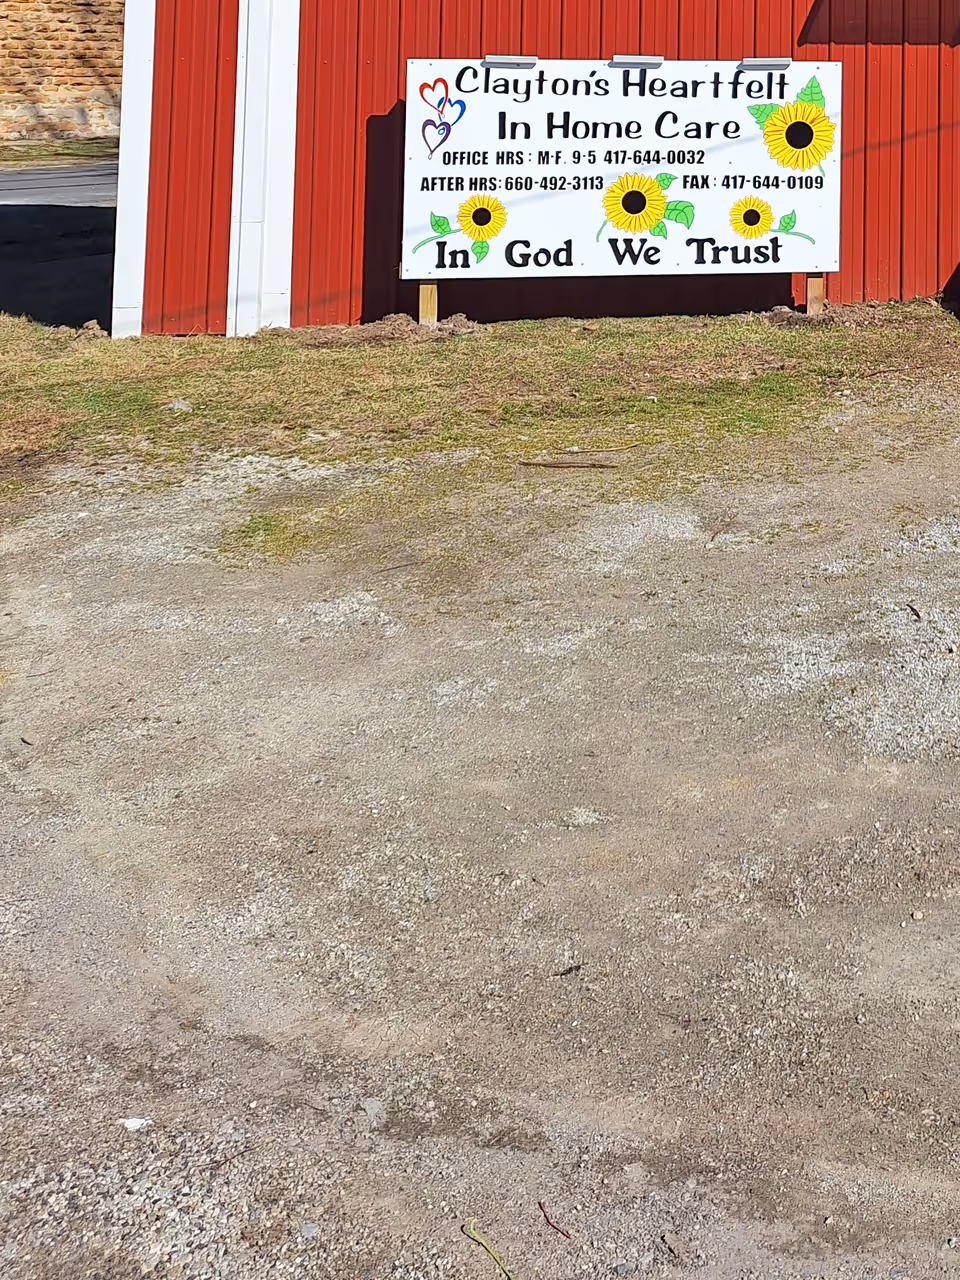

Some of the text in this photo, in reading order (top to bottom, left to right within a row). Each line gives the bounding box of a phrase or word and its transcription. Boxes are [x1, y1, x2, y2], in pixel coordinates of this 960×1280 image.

[455, 65, 789, 103] Clayton's Heartfelt
[498, 110, 741, 140] In Home Care
[442, 151, 489, 166] OFFICE
[603, 150, 705, 165] 417-644-0032
[420, 176, 465, 192] AFTER
[504, 176, 604, 191] 660-492-3113
[721, 175, 824, 190] 417-644-0109
[435, 236, 784, 269] In God We Trust
